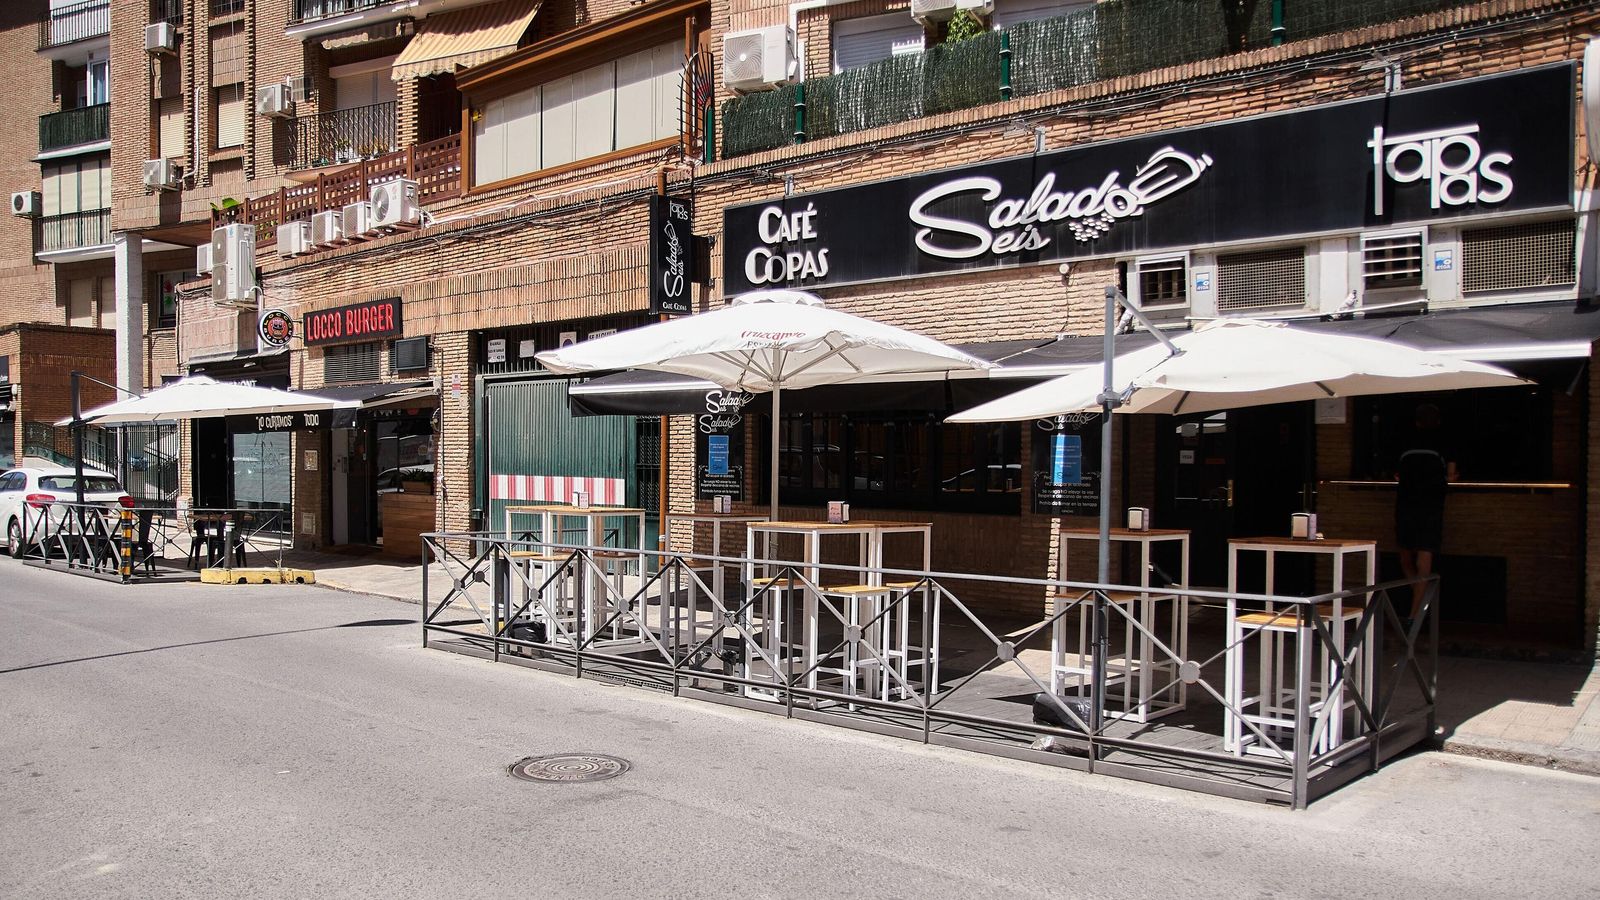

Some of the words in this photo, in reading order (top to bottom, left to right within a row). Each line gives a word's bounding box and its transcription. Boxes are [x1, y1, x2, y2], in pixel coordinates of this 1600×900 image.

[758, 202, 818, 244] CAFÉ
[744, 248, 829, 285] COPAS
[306, 311, 342, 342] LOCCO
[345, 303, 394, 336] BURGER
[303, 413, 320, 427] TODO
